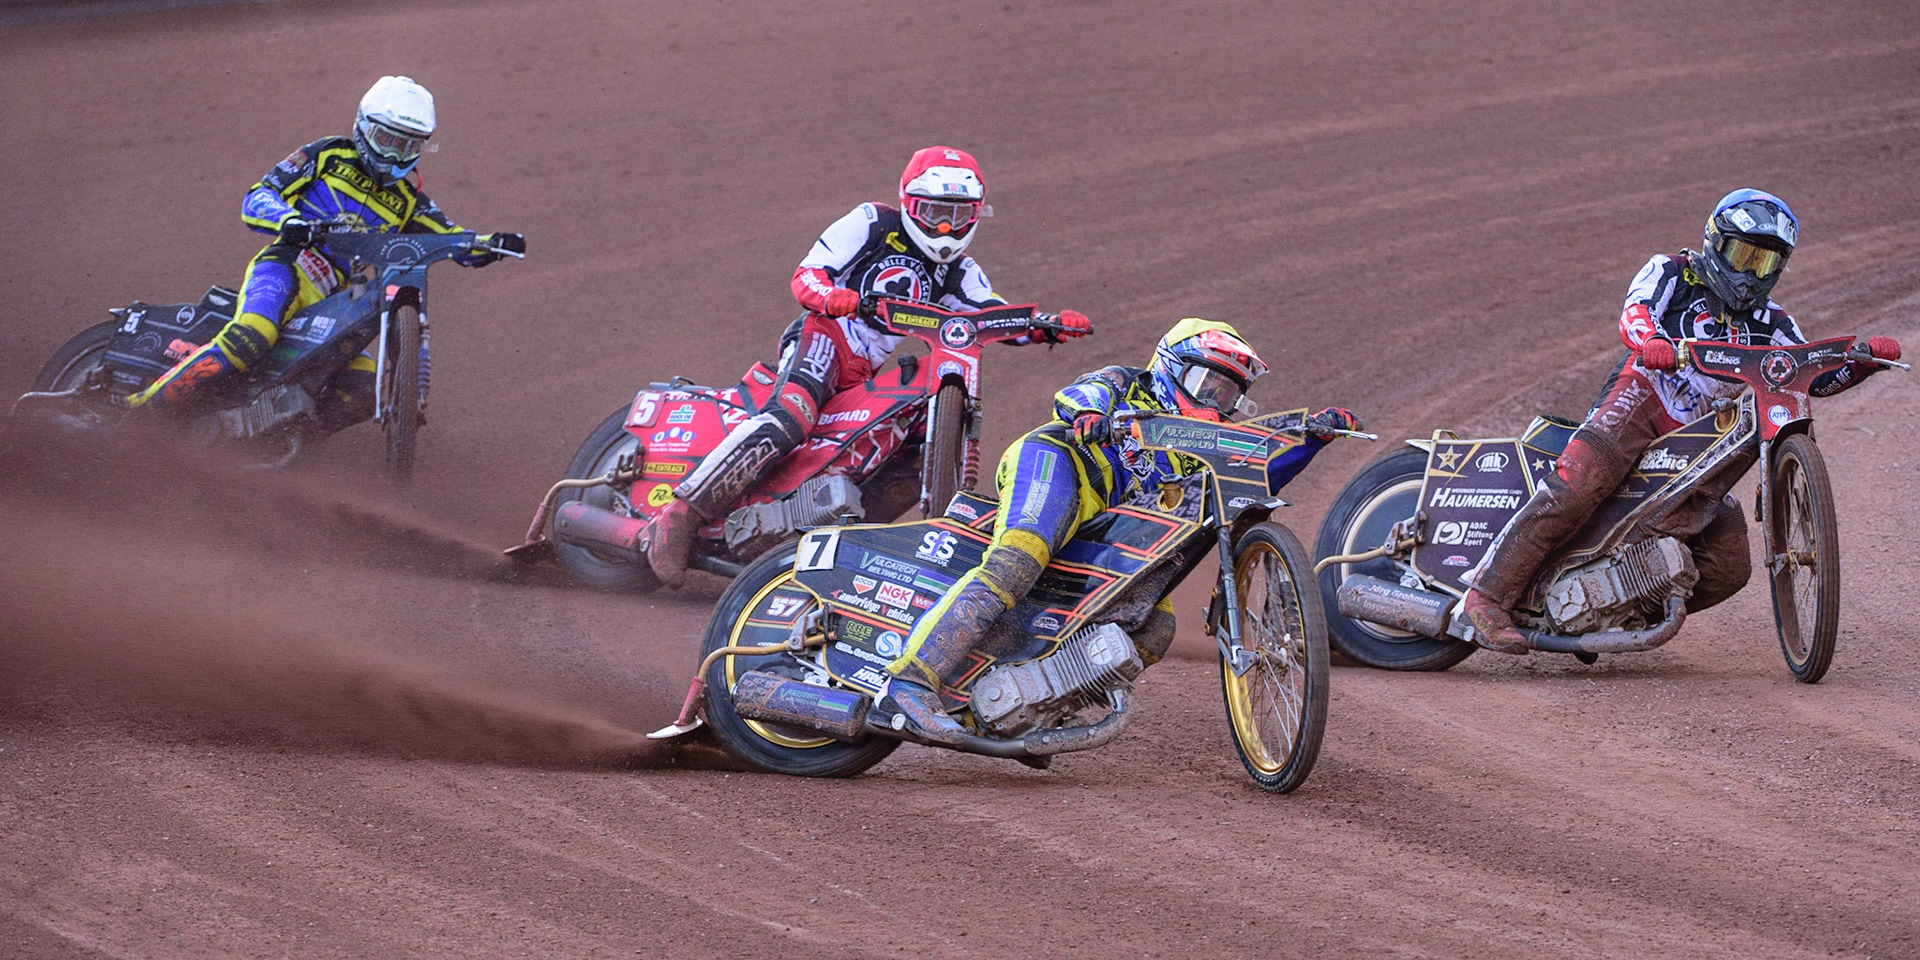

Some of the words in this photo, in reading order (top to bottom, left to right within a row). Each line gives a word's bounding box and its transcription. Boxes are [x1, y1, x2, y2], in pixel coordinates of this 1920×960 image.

[335, 163, 363, 185] TRU
[878, 257, 907, 270] BELLE
[124, 311, 142, 333] 5
[1815, 381, 1842, 396] Trans
[1836, 366, 1852, 385] MF
[633, 393, 660, 424] 5
[817, 409, 871, 426] BETARD
[1150, 423, 1218, 444] VULCATECH
[1429, 487, 1520, 509] HAUMERSEN
[1466, 530, 1494, 540] Stiftung
[1469, 521, 1488, 530] ADAC
[808, 534, 833, 567] 7
[1463, 538, 1483, 547] Sport
[860, 551, 918, 576] VULCATECH
[855, 576, 876, 588] ROCOL
[867, 565, 897, 581] BELTING
[896, 571, 913, 584] LTD
[831, 589, 881, 614] Cambridge
[880, 585, 912, 603] NGK
[1368, 583, 1390, 597] Jörg
[1391, 588, 1441, 608] Grohmann
[766, 595, 804, 618] 57
[846, 620, 873, 637] RRE
